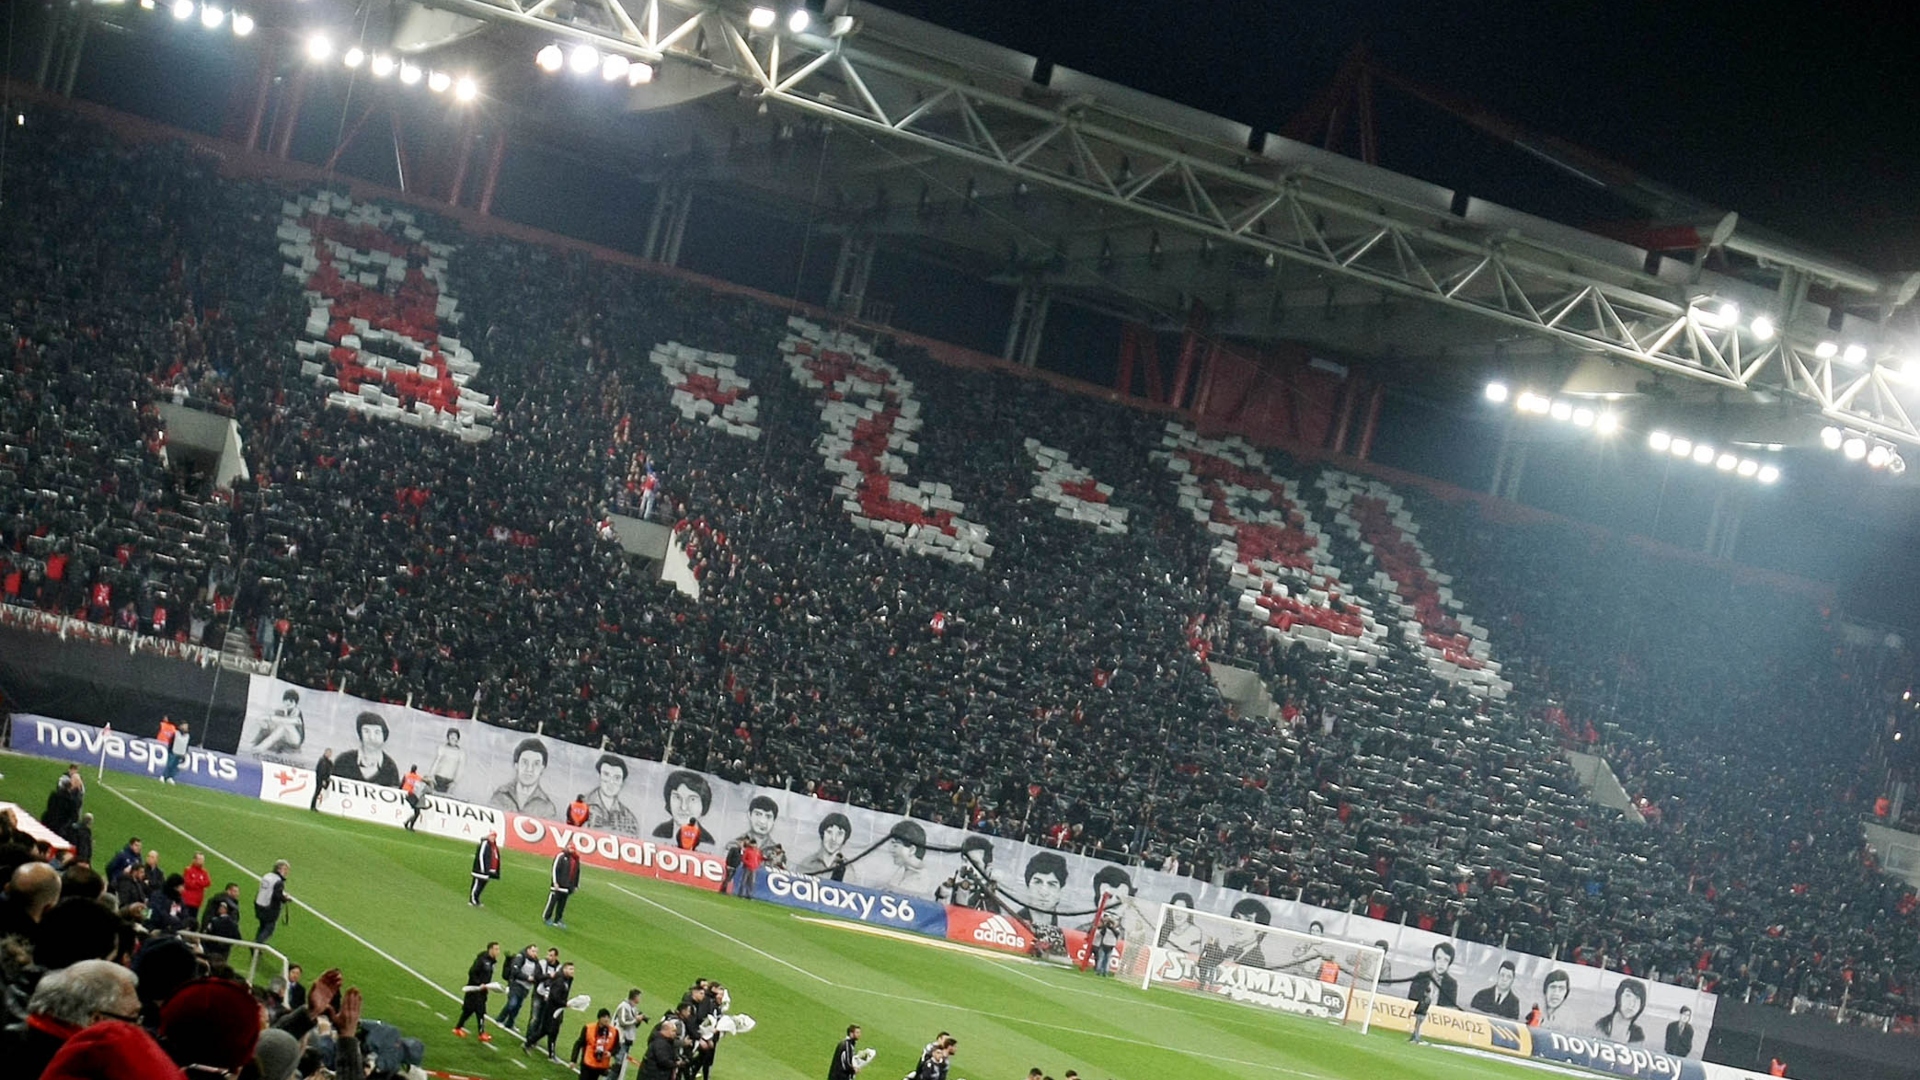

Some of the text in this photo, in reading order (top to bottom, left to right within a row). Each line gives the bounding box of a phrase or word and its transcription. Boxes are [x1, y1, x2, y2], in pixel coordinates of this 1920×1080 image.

[317, 793, 494, 836] HOSPITA
[549, 825, 724, 881] vodafone
[767, 873, 915, 921] Galaxy S6
[973, 927, 1025, 948] adidas
[1163, 950, 1322, 1004] STXIMAN
[1551, 1032, 1683, 1080] nova3play
